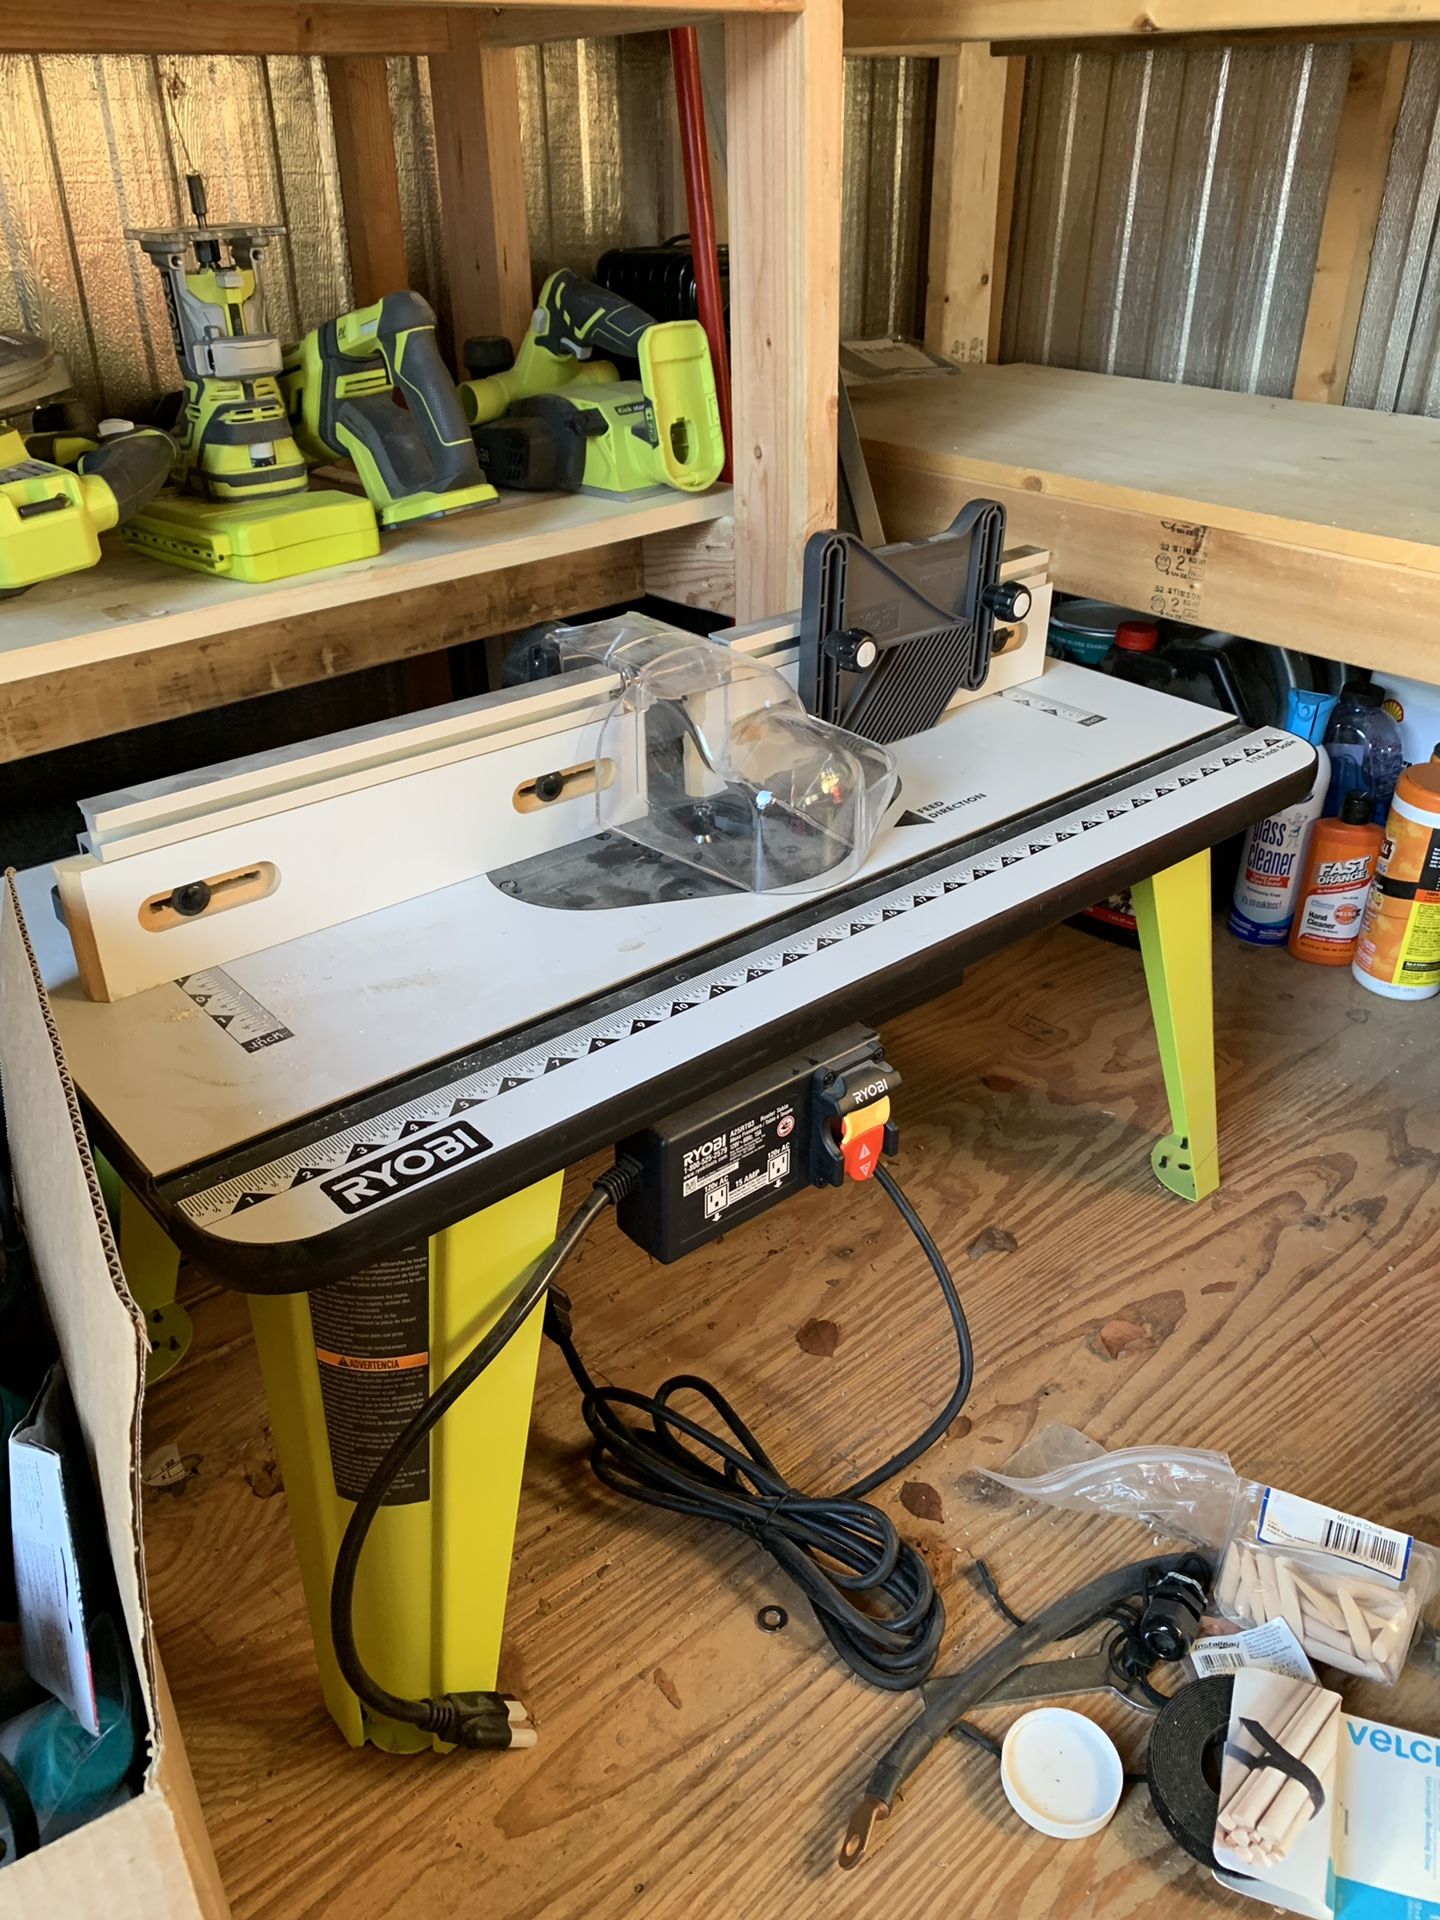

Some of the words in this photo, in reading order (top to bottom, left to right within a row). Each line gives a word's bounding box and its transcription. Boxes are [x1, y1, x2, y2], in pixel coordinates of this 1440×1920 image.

[1176, 555, 1186, 572] 2
[1246, 754, 1264, 764] 1/16
[916, 801, 944, 814] FEED
[928, 793, 986, 818] DIRECTION
[1252, 818, 1287, 847] glass
[1247, 844, 1296, 876] cleaner
[1319, 856, 1371, 877] FAST
[1318, 870, 1367, 885] ORANGE
[1306, 919, 1336, 930] Cleaner
[1308, 911, 1328, 921] Hand
[246, 1196, 254, 1204] 1
[302, 1171, 314, 1180] 2
[356, 1146, 368, 1155] 3
[409, 1122, 420, 1132] 4
[459, 1100, 470, 1108] 5
[552, 1059, 560, 1067] 7
[596, 1040, 605, 1048] 8
[674, 1002, 688, 1011] 10
[713, 986, 724, 994] 11
[750, 970, 762, 978] 12
[785, 954, 798, 962] 13
[819, 938, 832, 946] 14
[852, 924, 866, 932] 15
[884, 910, 898, 918] 16
[915, 896, 928, 904] 17
[945, 882, 958, 890] 18
[852, 1078, 888, 1104] RYOBI
[683, 1134, 726, 1167] RYOBI
[768, 1148, 780, 1158] 120v
[782, 1142, 790, 1150] AC
[332, 1128, 479, 1204] RYOBI
[704, 1182, 718, 1192] 120v
[720, 1175, 728, 1184] AC
[736, 1180, 742, 1188] 15
[744, 1169, 760, 1182] AMP
[349, 1360, 400, 1370] ADVERTENCIA
[1337, 1514, 1355, 1526] Made
[1363, 1524, 1382, 1536] China
